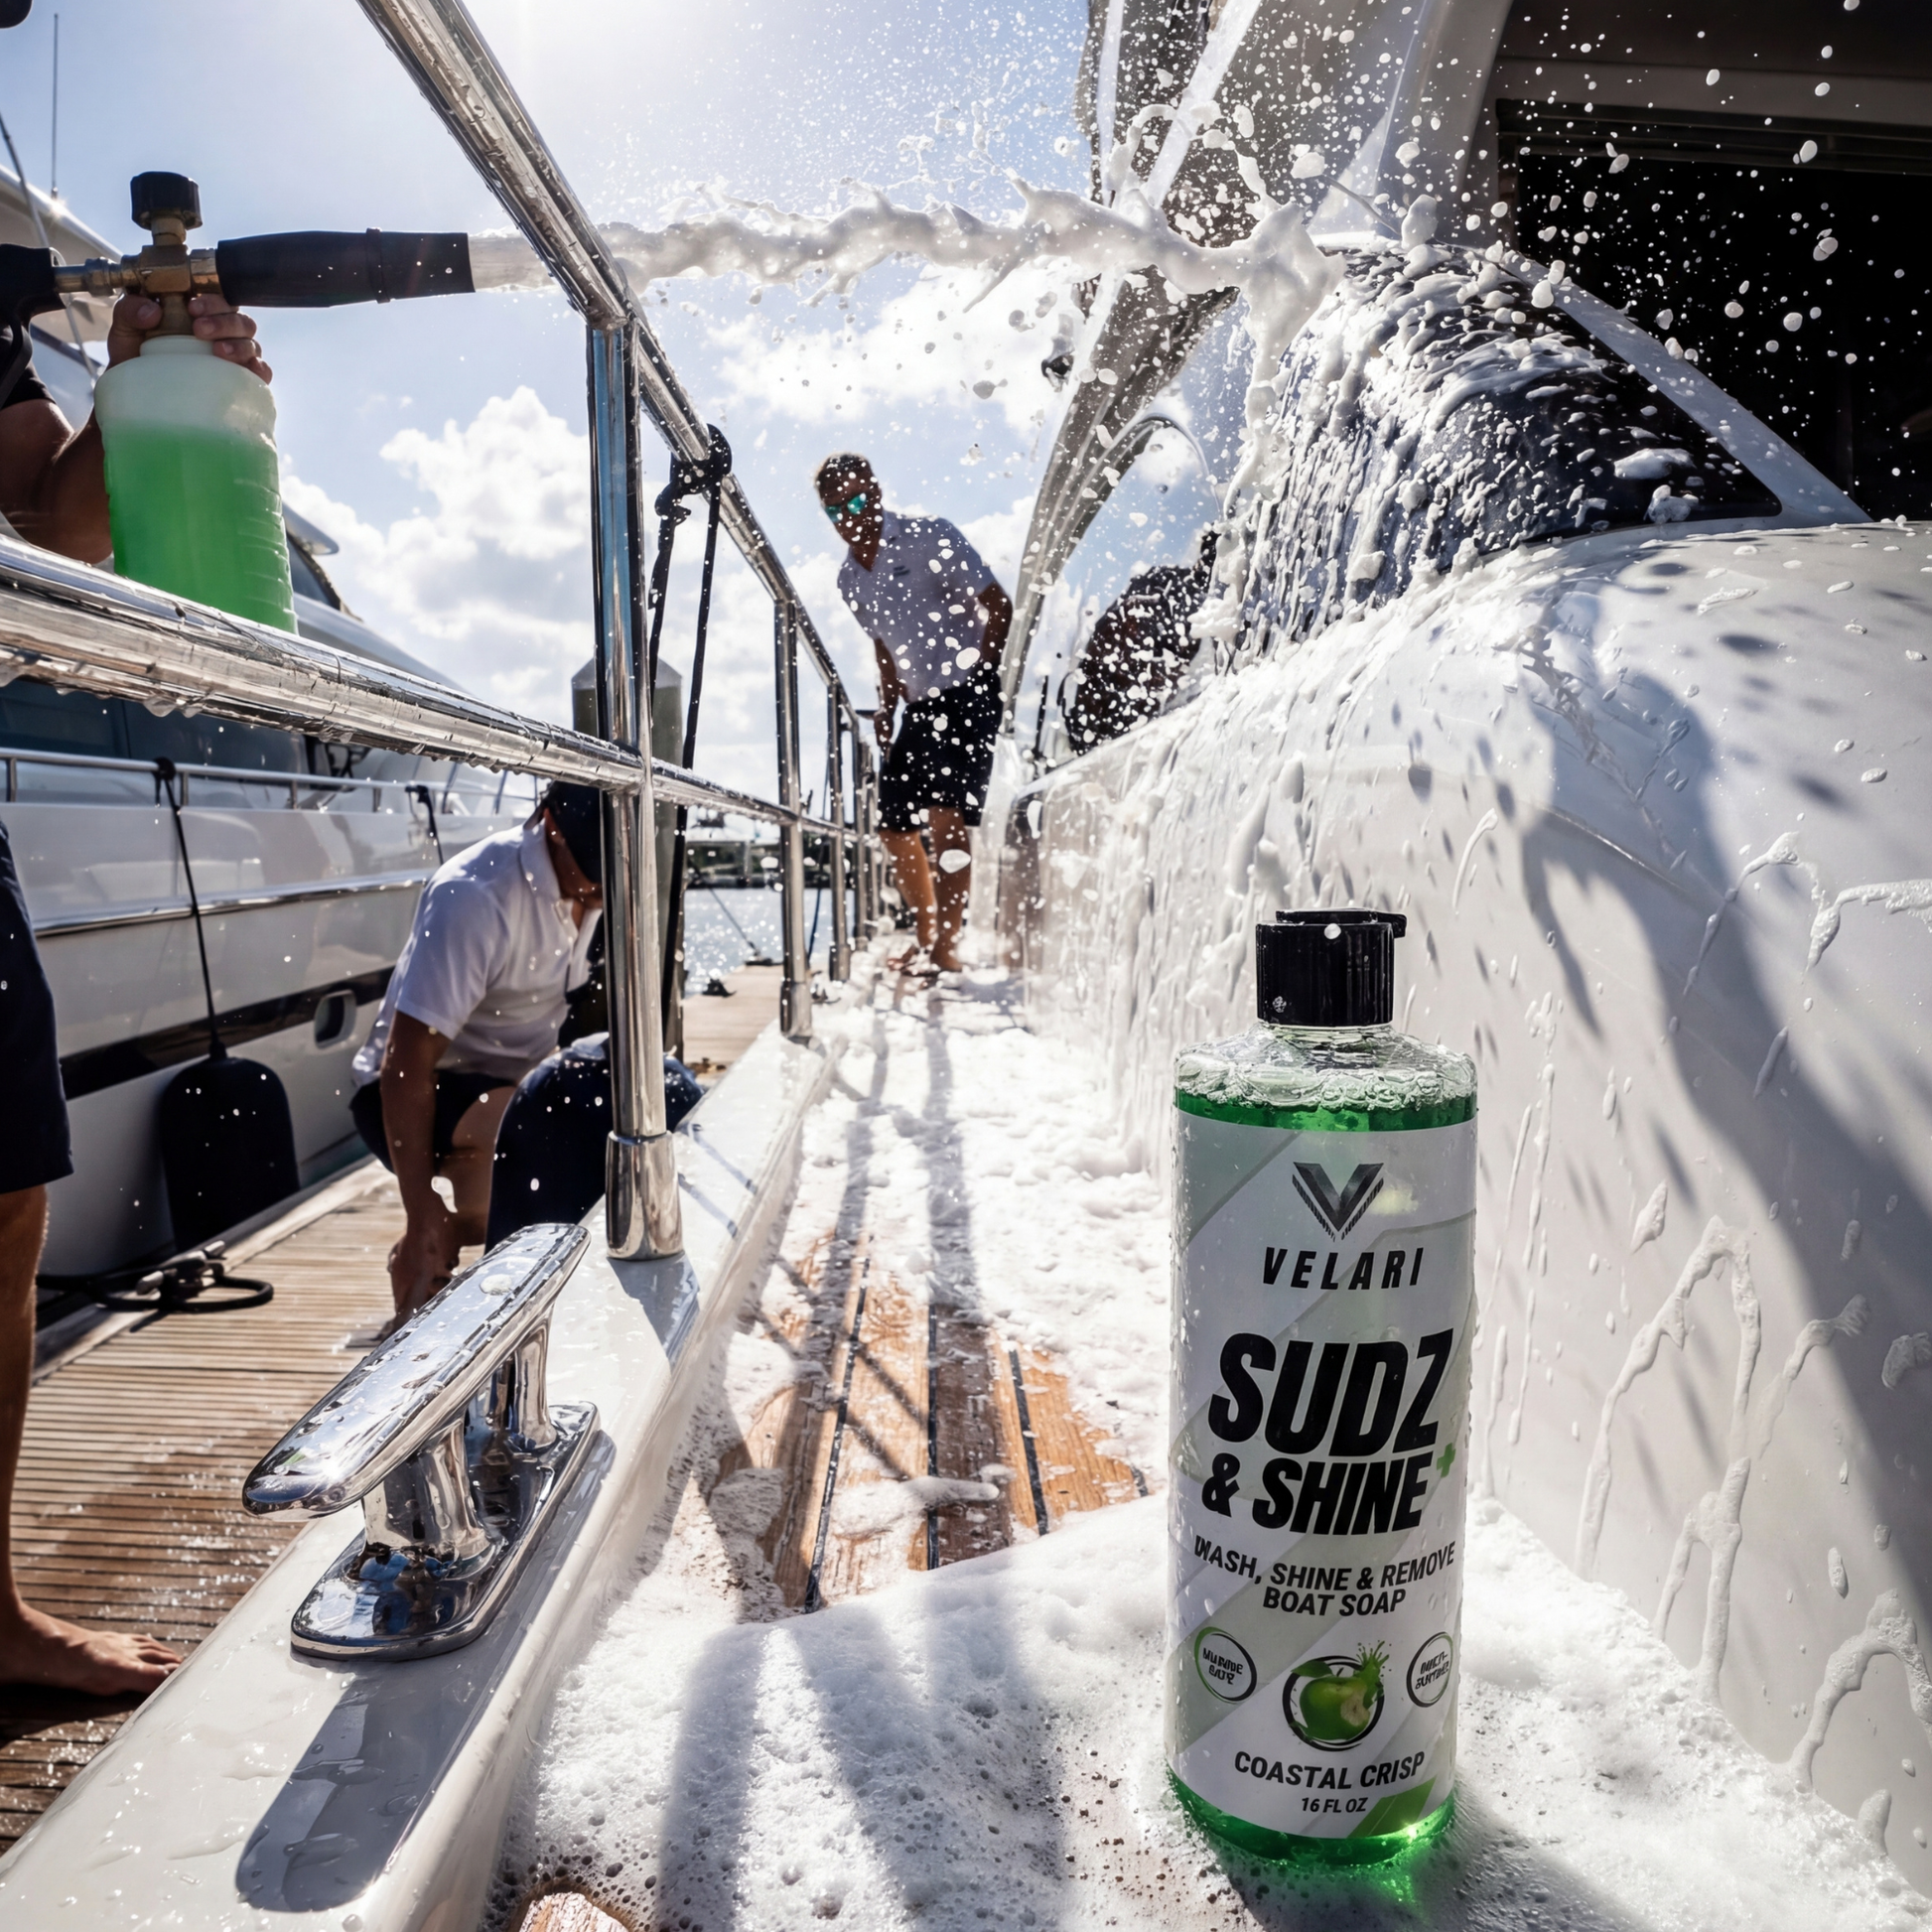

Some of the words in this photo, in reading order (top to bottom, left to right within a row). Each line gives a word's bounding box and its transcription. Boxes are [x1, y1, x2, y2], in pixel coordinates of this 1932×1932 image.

[1263, 1247, 1424, 1290] VELARI
[1208, 1328, 1453, 1456] SUDZ
[1201, 1452, 1240, 1517] &
[1252, 1450, 1434, 1536] SHINE
[1194, 1535, 1263, 1585] WASH,
[1270, 1563, 1351, 1590] SHINE
[1356, 1567, 1374, 1590] &
[1380, 1541, 1455, 1587] REMOVE
[1263, 1587, 1334, 1616] BOAT
[1339, 1588, 1406, 1616] SOAP
[1234, 1751, 1352, 1789] COASTAL
[1360, 1751, 1425, 1788] CRISP
[1301, 1797, 1319, 1812] 16
[1322, 1799, 1342, 1813] FL
[1345, 1797, 1368, 1813] OZ
